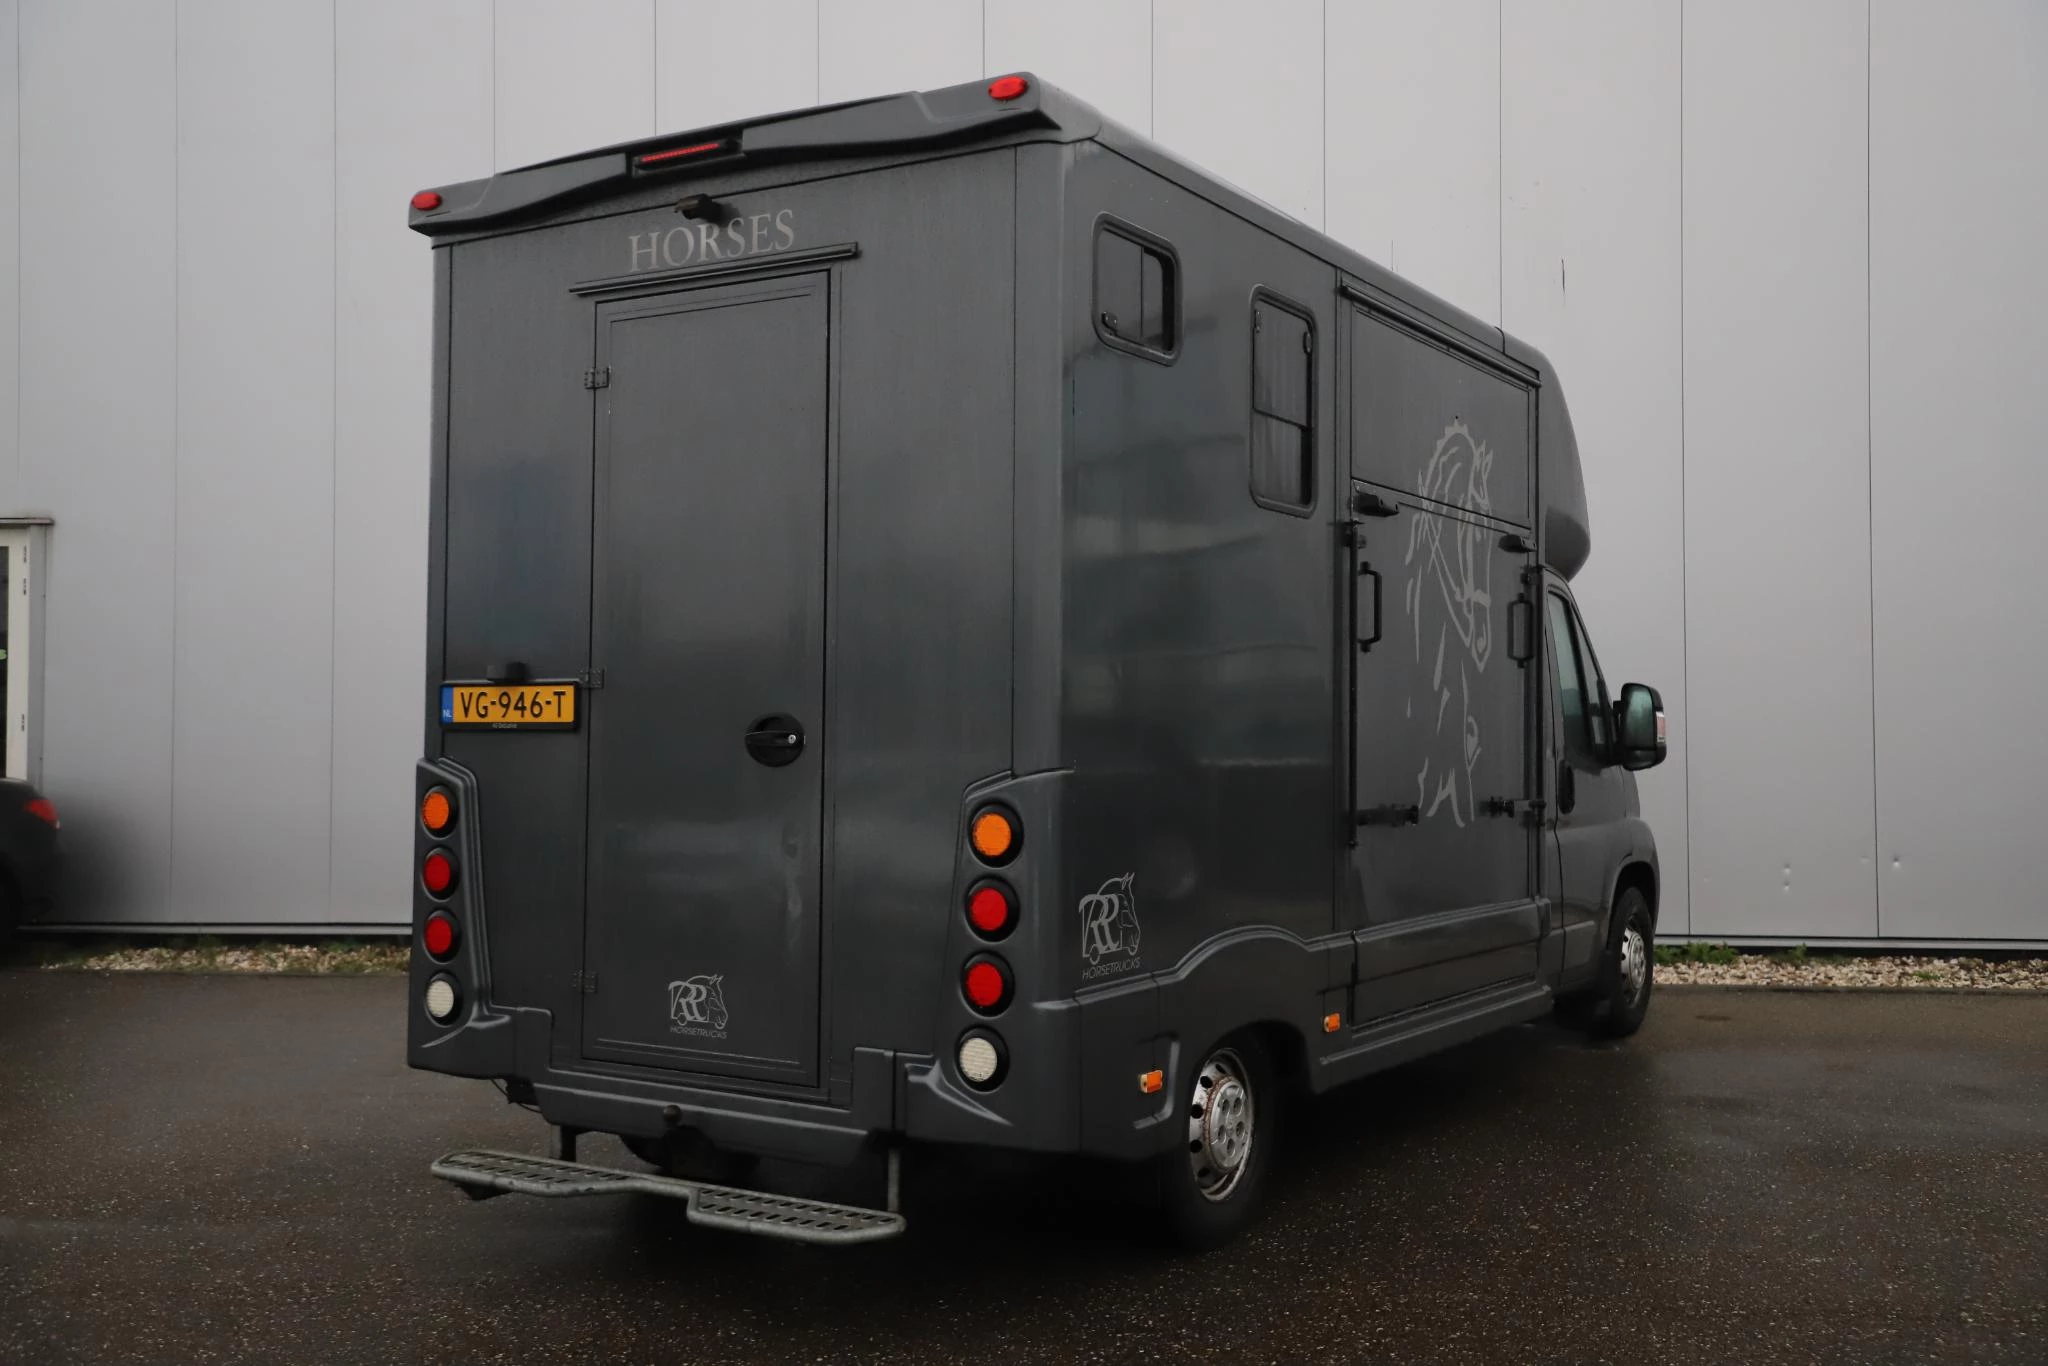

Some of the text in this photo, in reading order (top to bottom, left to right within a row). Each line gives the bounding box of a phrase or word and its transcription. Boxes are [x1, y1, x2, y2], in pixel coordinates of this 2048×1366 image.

[628, 208, 795, 273] HORSES
[460, 691, 566, 718] VG-946-T
[1082, 956, 1141, 981] HORSETRUCKS
